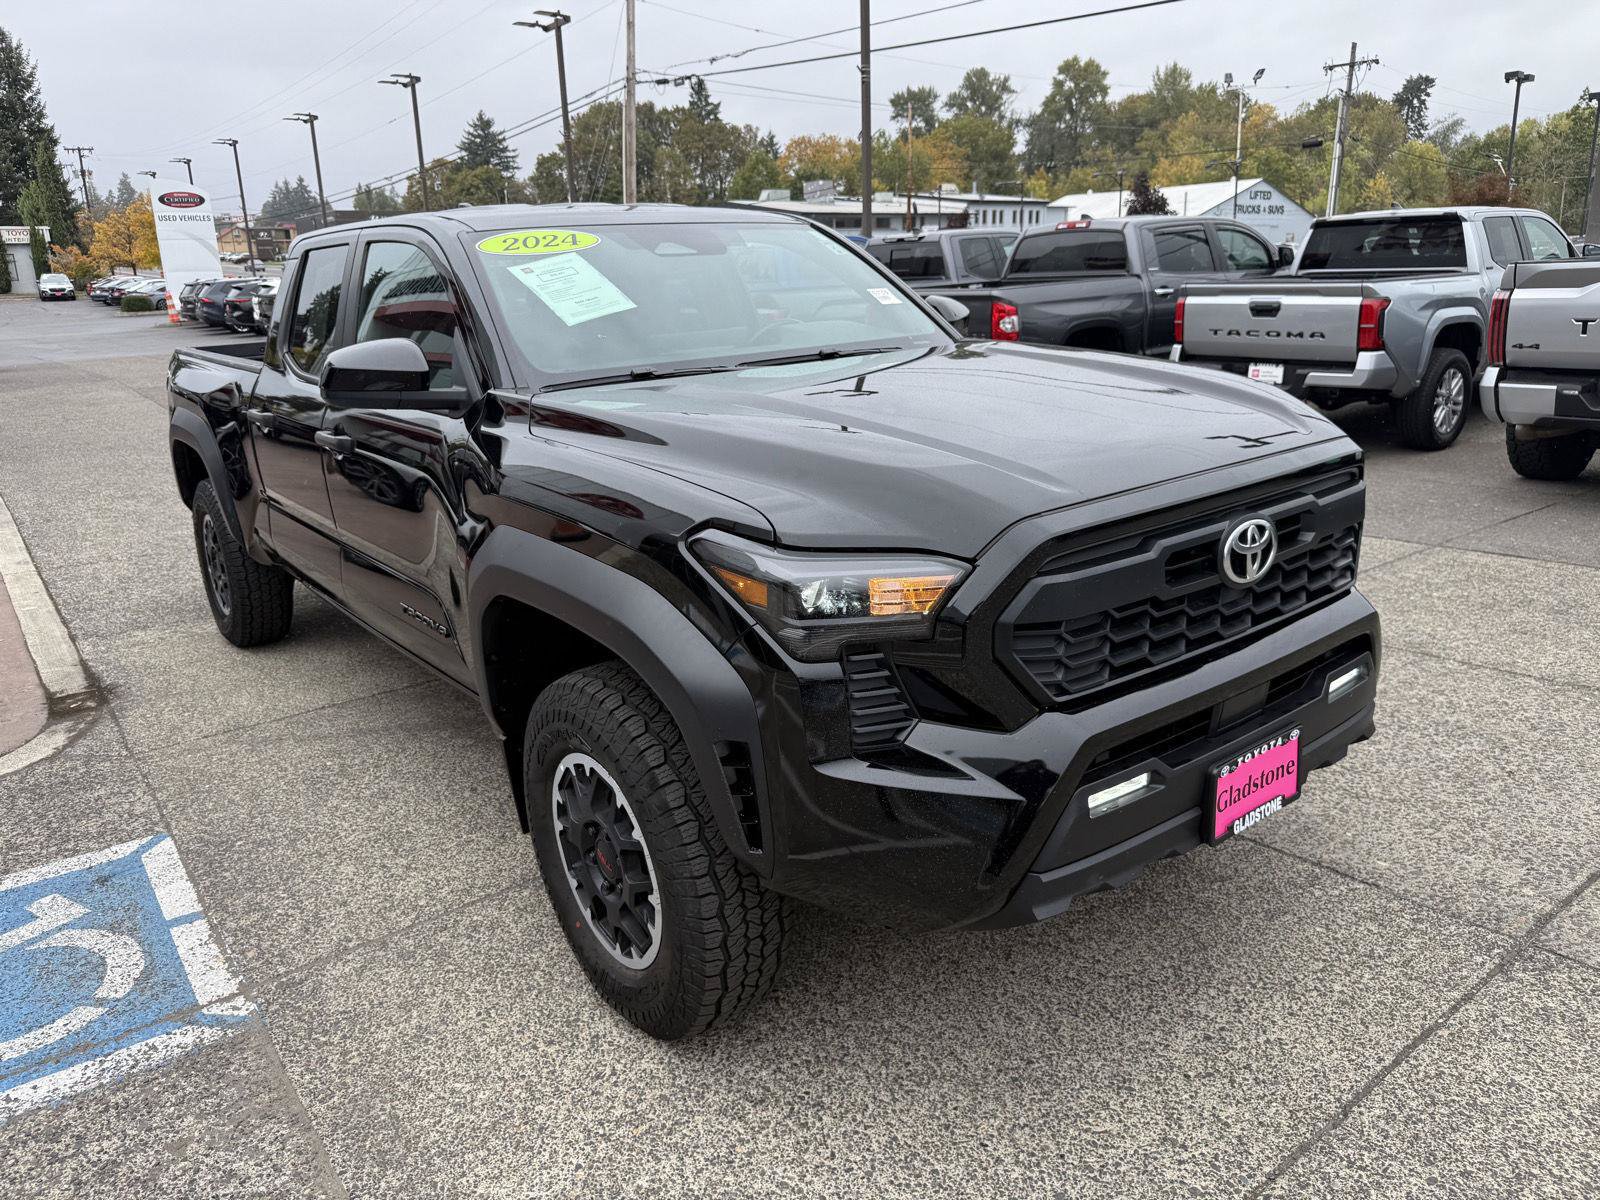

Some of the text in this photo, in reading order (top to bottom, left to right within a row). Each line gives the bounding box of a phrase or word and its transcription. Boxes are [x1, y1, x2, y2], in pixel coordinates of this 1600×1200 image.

[1249, 190, 1272, 200] LIFTED
[178, 214, 211, 222] VEHICLES
[502, 233, 581, 251] 2024
[1208, 328, 1326, 340] TACOMA
[1236, 736, 1283, 767] TOYOTA
[1216, 759, 1296, 813] Gladstone
[1233, 795, 1283, 835] GLADSTONE
